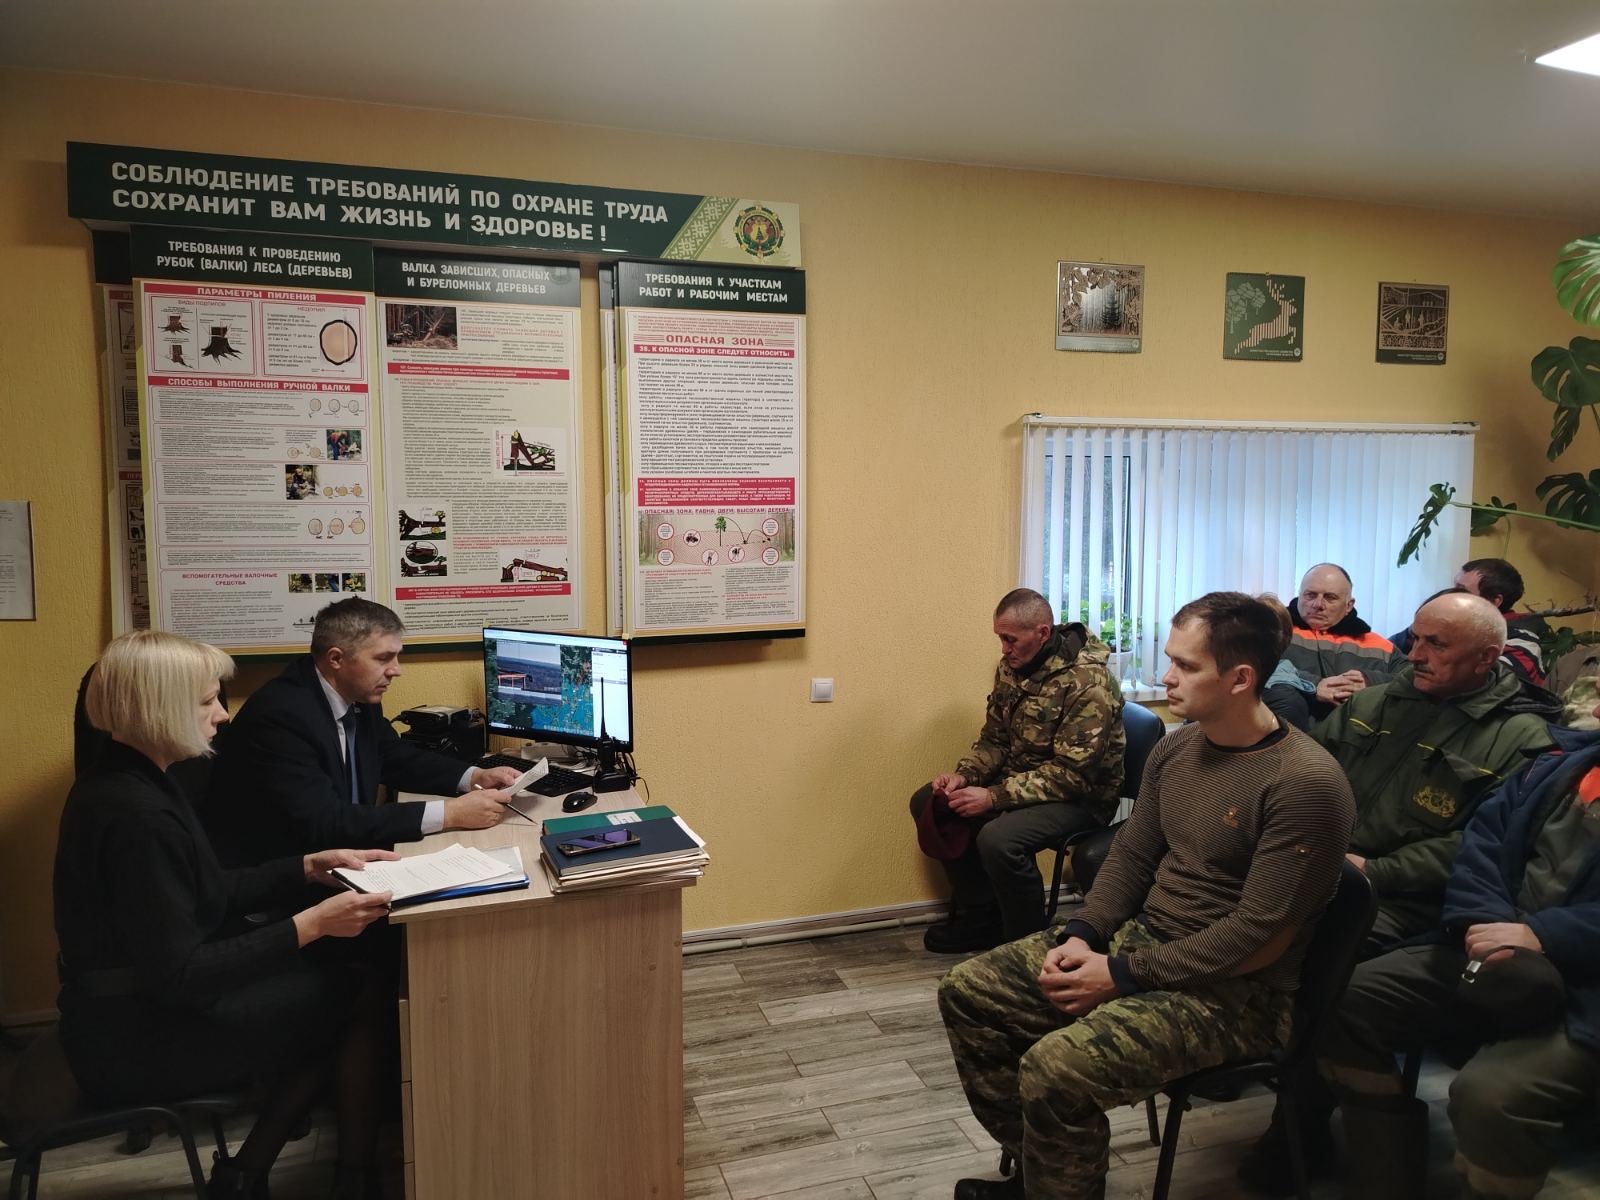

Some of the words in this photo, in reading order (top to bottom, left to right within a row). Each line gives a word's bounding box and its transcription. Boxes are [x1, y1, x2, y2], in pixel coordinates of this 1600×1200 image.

[112, 162, 294, 193] СОБЛЮДЕНИЕ
[307, 177, 459, 205] ТРЕБОВАНИЙ
[471, 190, 500, 209] ПО
[512, 194, 593, 217] ОХРАНЕ
[604, 201, 668, 223] ТРУДА
[112, 189, 255, 216] СОХРАНИТ
[271, 202, 326, 221] ВАМ
[340, 206, 431, 228] ЖИЗНЬ
[445, 212, 460, 231] И
[471, 215, 593, 241] ЗДОРОВЬЕ
[168, 240, 243, 256] ТРЕБОВАНИЯ
[250, 246, 257, 257] К
[262, 247, 341, 263] ПРОВЕДЕНИЮ
[157, 256, 195, 268] РУБОК
[200, 258, 248, 273] (ВАЛКИ)
[253, 262, 283, 274] ЛЕСА
[288, 264, 353, 280] (ДЕРЕВЬЕВ)
[402, 262, 436, 274] ВАЛКА
[440, 265, 500, 279] ЗАВИСШИХ,
[502, 269, 550, 281] ОПАСНЫХ
[407, 277, 414, 288] И
[420, 278, 491, 292] БУРЕЛОМНЫХ
[496, 282, 546, 295] ДЕРЕВЬЕВ
[645, 273, 713, 286] ТРЕБОВАНИЯ
[717, 277, 724, 287] К
[729, 277, 782, 290] УЧАСТКАМ
[197, 287, 262, 298] ПАРАМЕТРЫ
[268, 291, 317, 301] ПИЛЕНИЯ
[639, 287, 671, 299] РАБОТ
[677, 288, 685, 299] И
[690, 288, 739, 301] РАБОЧИМ
[747, 291, 788, 304] МЕСТАМ
[666, 334, 725, 345] ОПАСНАЯ
[732, 337, 764, 347] ЗОНА
[659, 346, 695, 354] ОПАСНОЙ
[696, 347, 716, 355] ЗОНЕ
[717, 348, 748, 356] СЛЕДУЕТ
[168, 378, 213, 387] СПОСОБЫ
[217, 379, 279, 389] ВЫПОЛНЕНИЯ
[283, 381, 318, 391] РУЧНОЙ
[322, 384, 351, 392] ВАЛКИ
